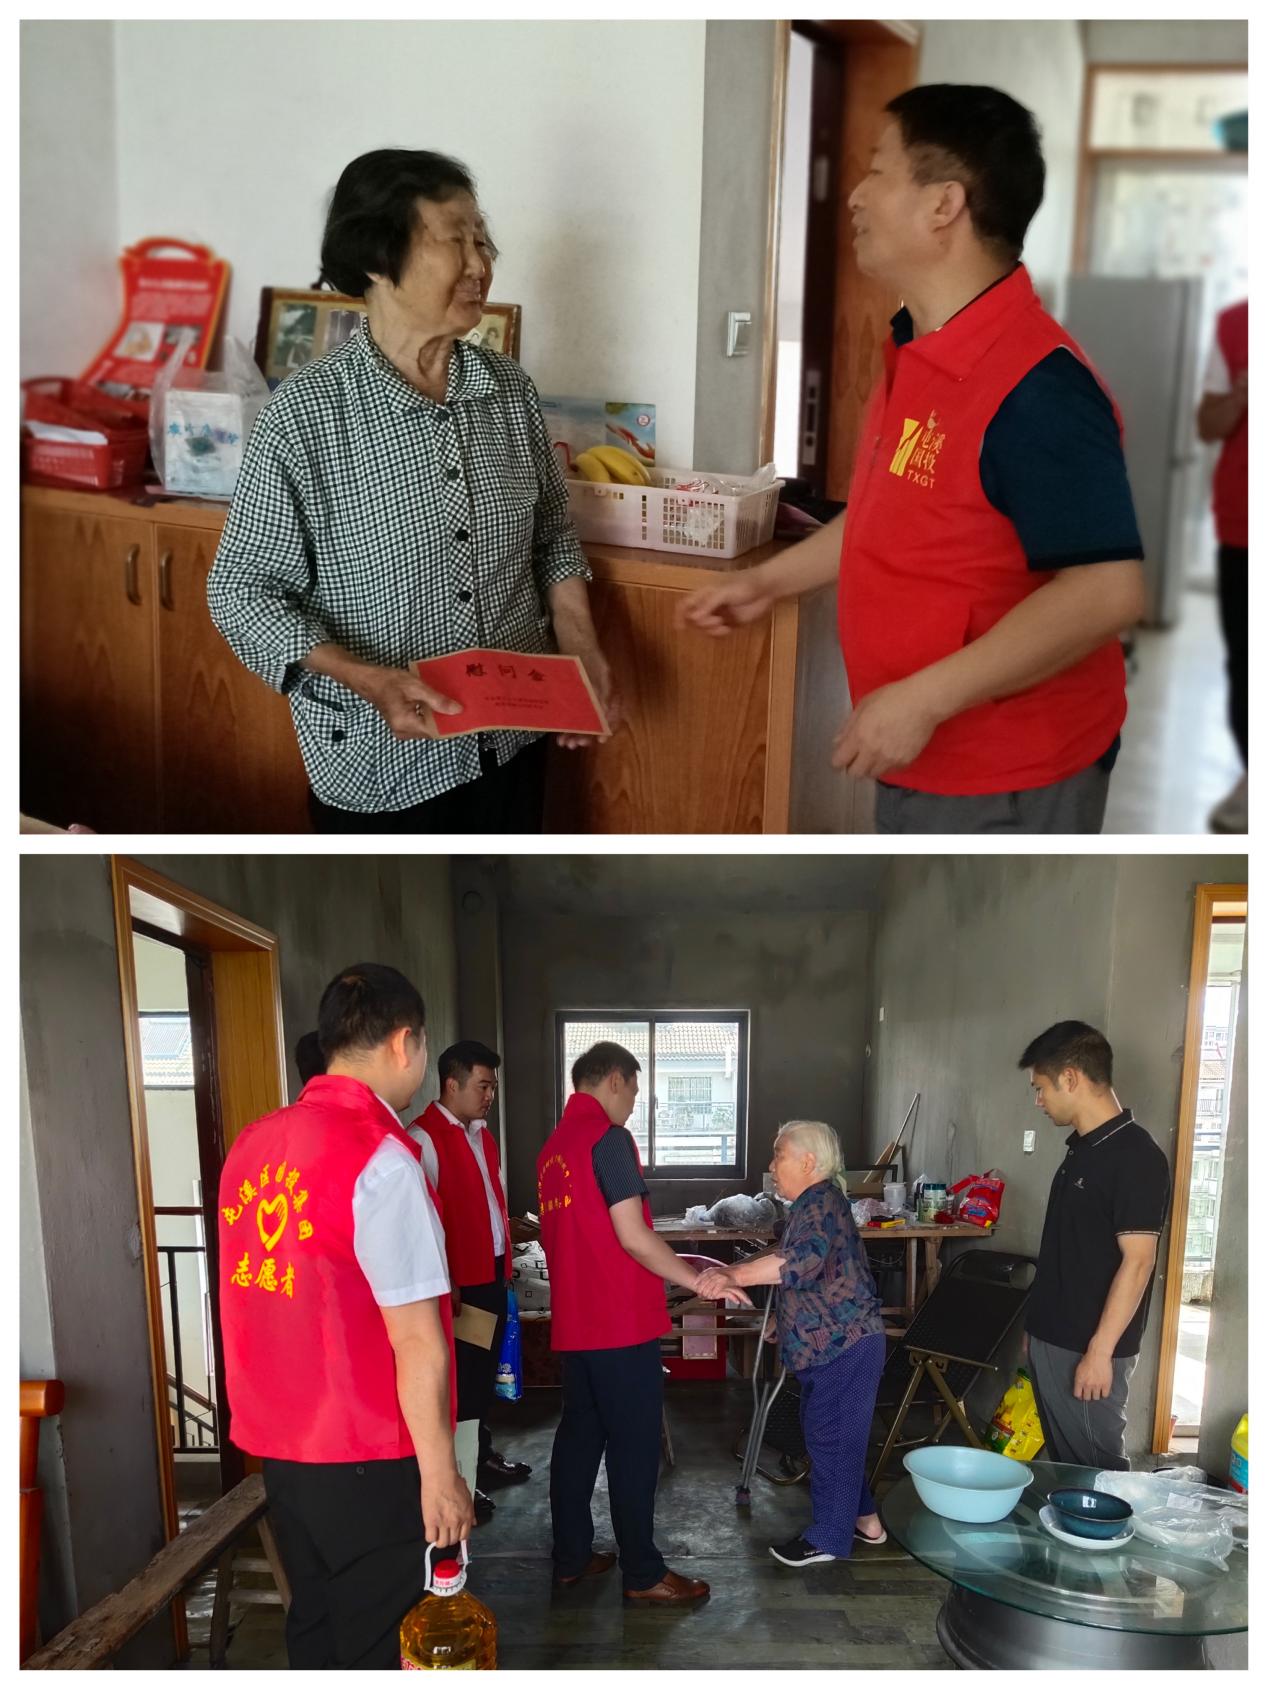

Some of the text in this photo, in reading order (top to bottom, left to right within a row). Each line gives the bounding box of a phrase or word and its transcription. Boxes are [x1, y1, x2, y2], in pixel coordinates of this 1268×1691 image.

[907, 470, 936, 489] TXGT
[465, 663, 546, 682] 慰问金
[231, 1252, 295, 1299] 志愿者
